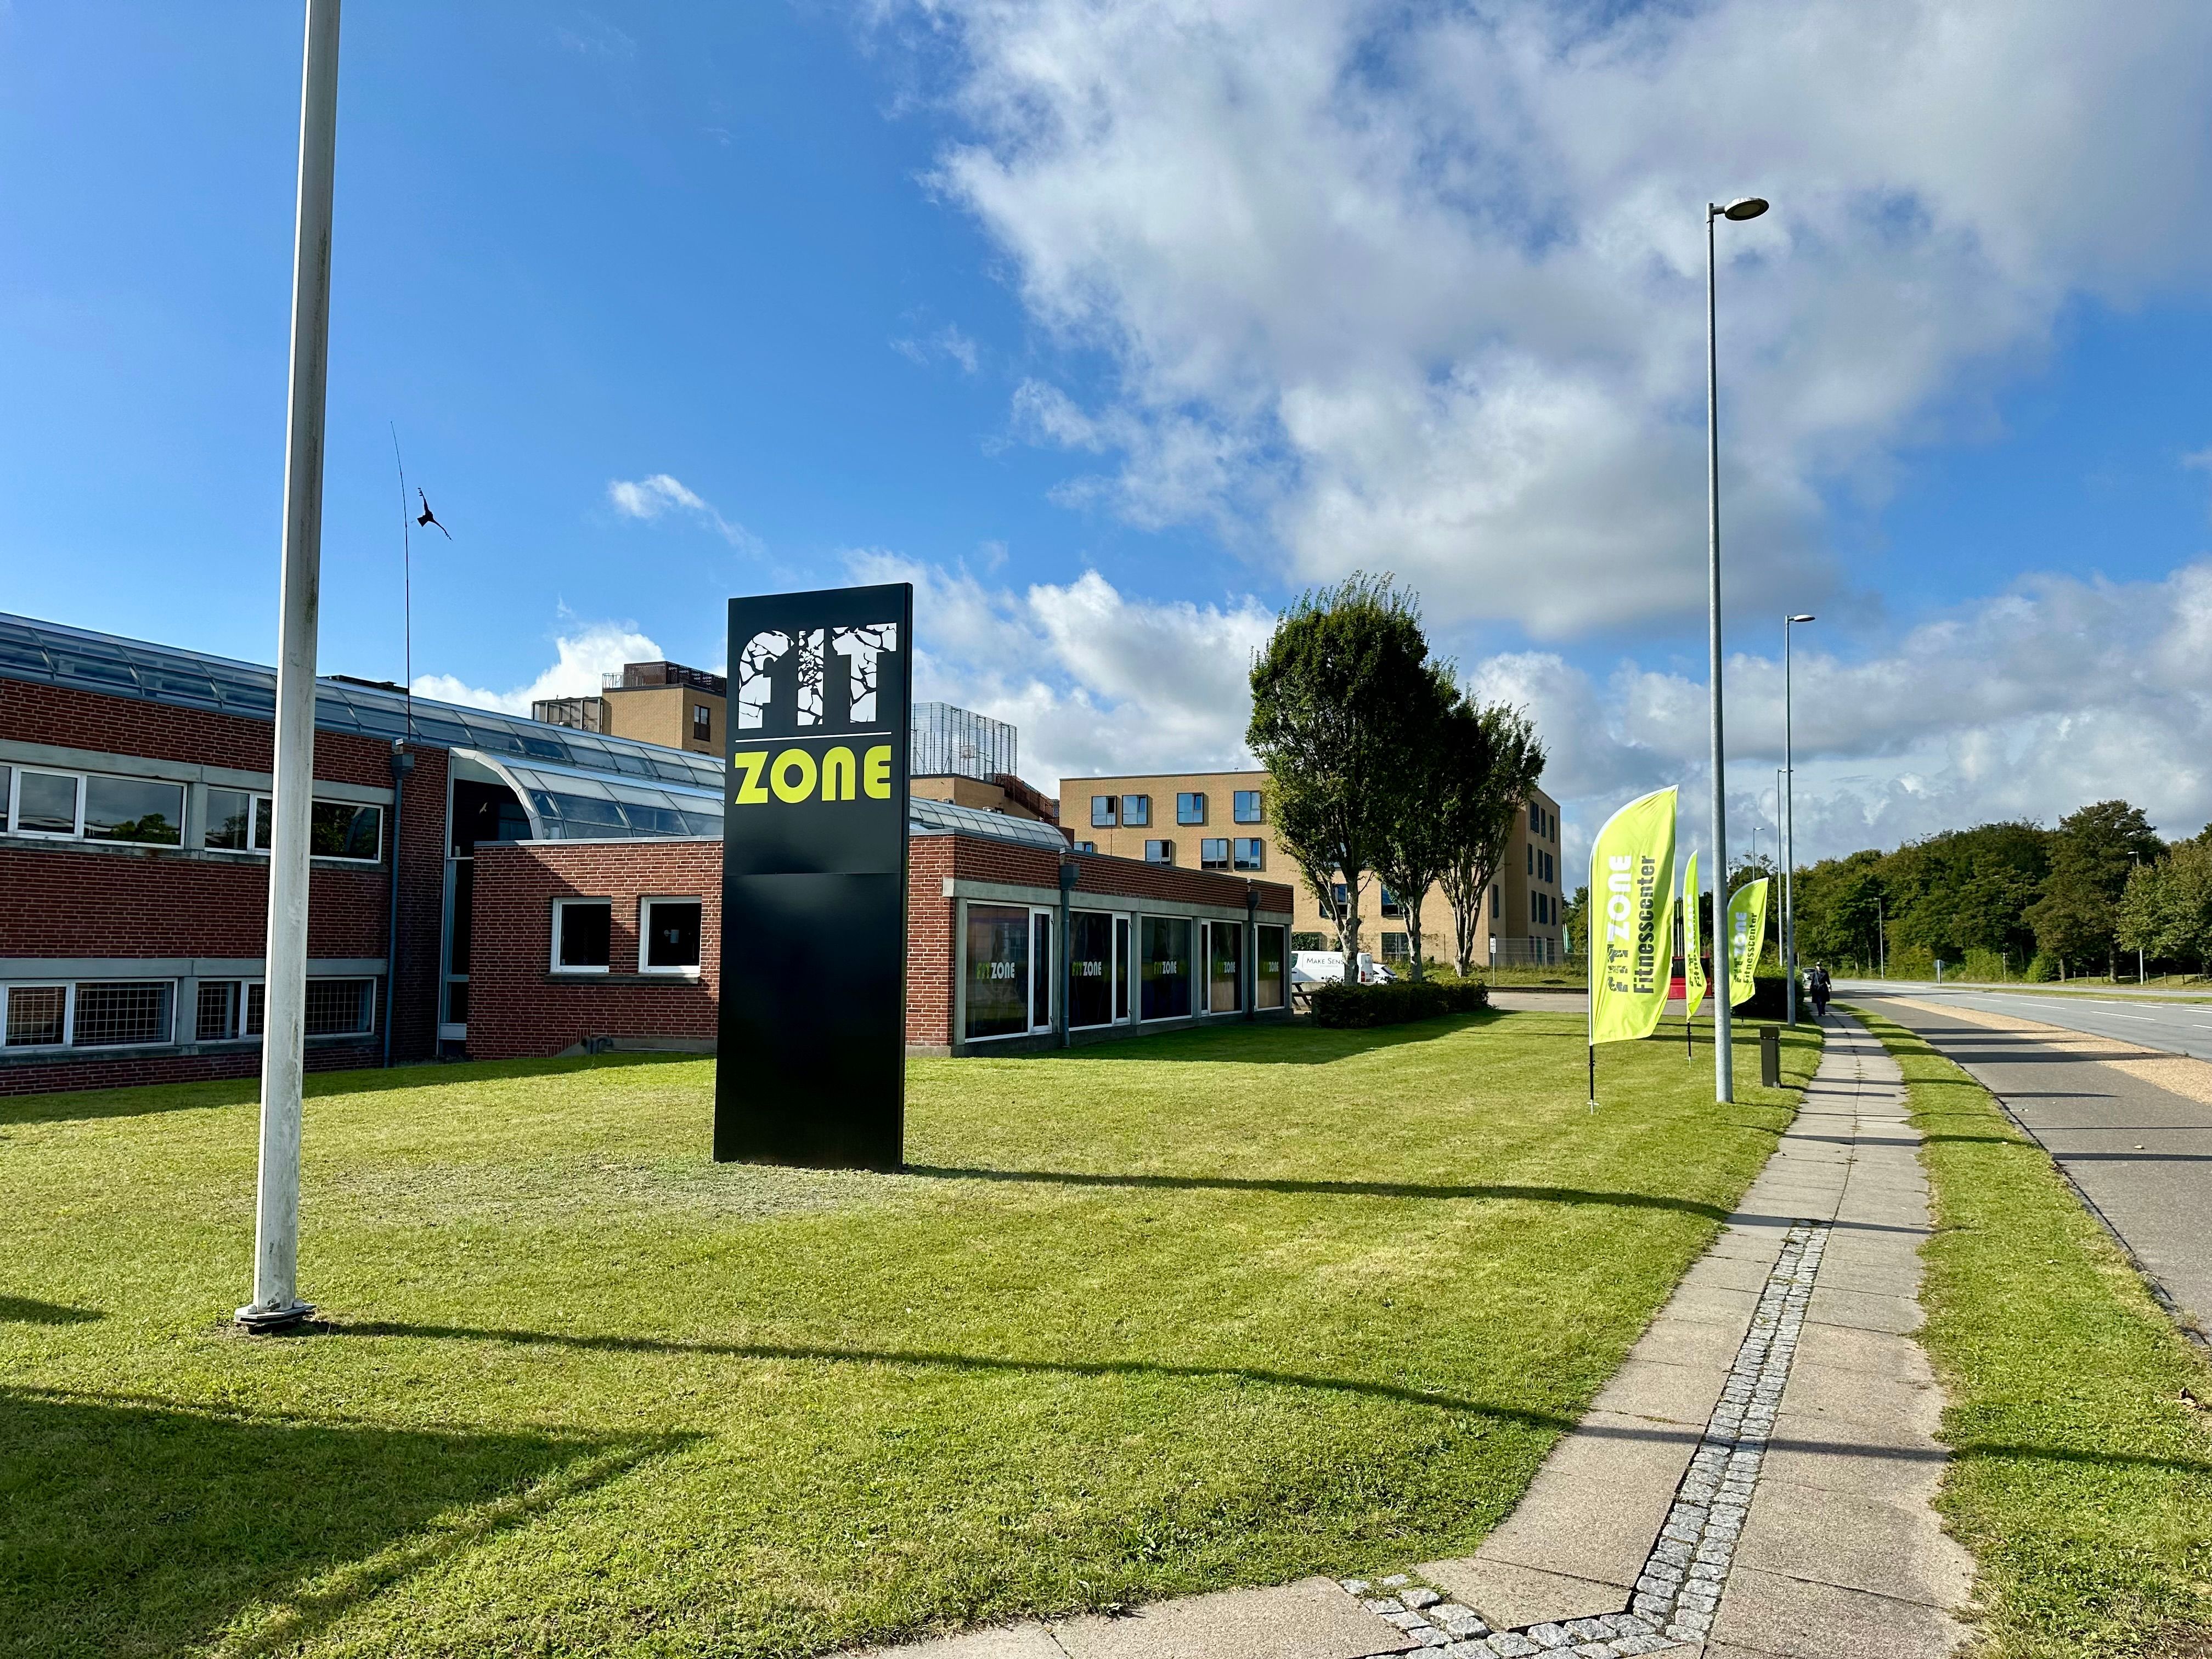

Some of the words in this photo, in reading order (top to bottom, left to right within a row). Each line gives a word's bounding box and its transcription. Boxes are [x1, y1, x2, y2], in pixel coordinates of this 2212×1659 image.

[738, 622, 897, 730] FIT
[735, 744, 891, 804] ZONE
[1607, 855, 1632, 942] ZONE
[1633, 855, 1655, 994] Fitnesscenter
[1607, 944, 1628, 993] FIT
[1734, 912, 1747, 958] ZONE
[1743, 912, 1757, 984] Fitnesscenter
